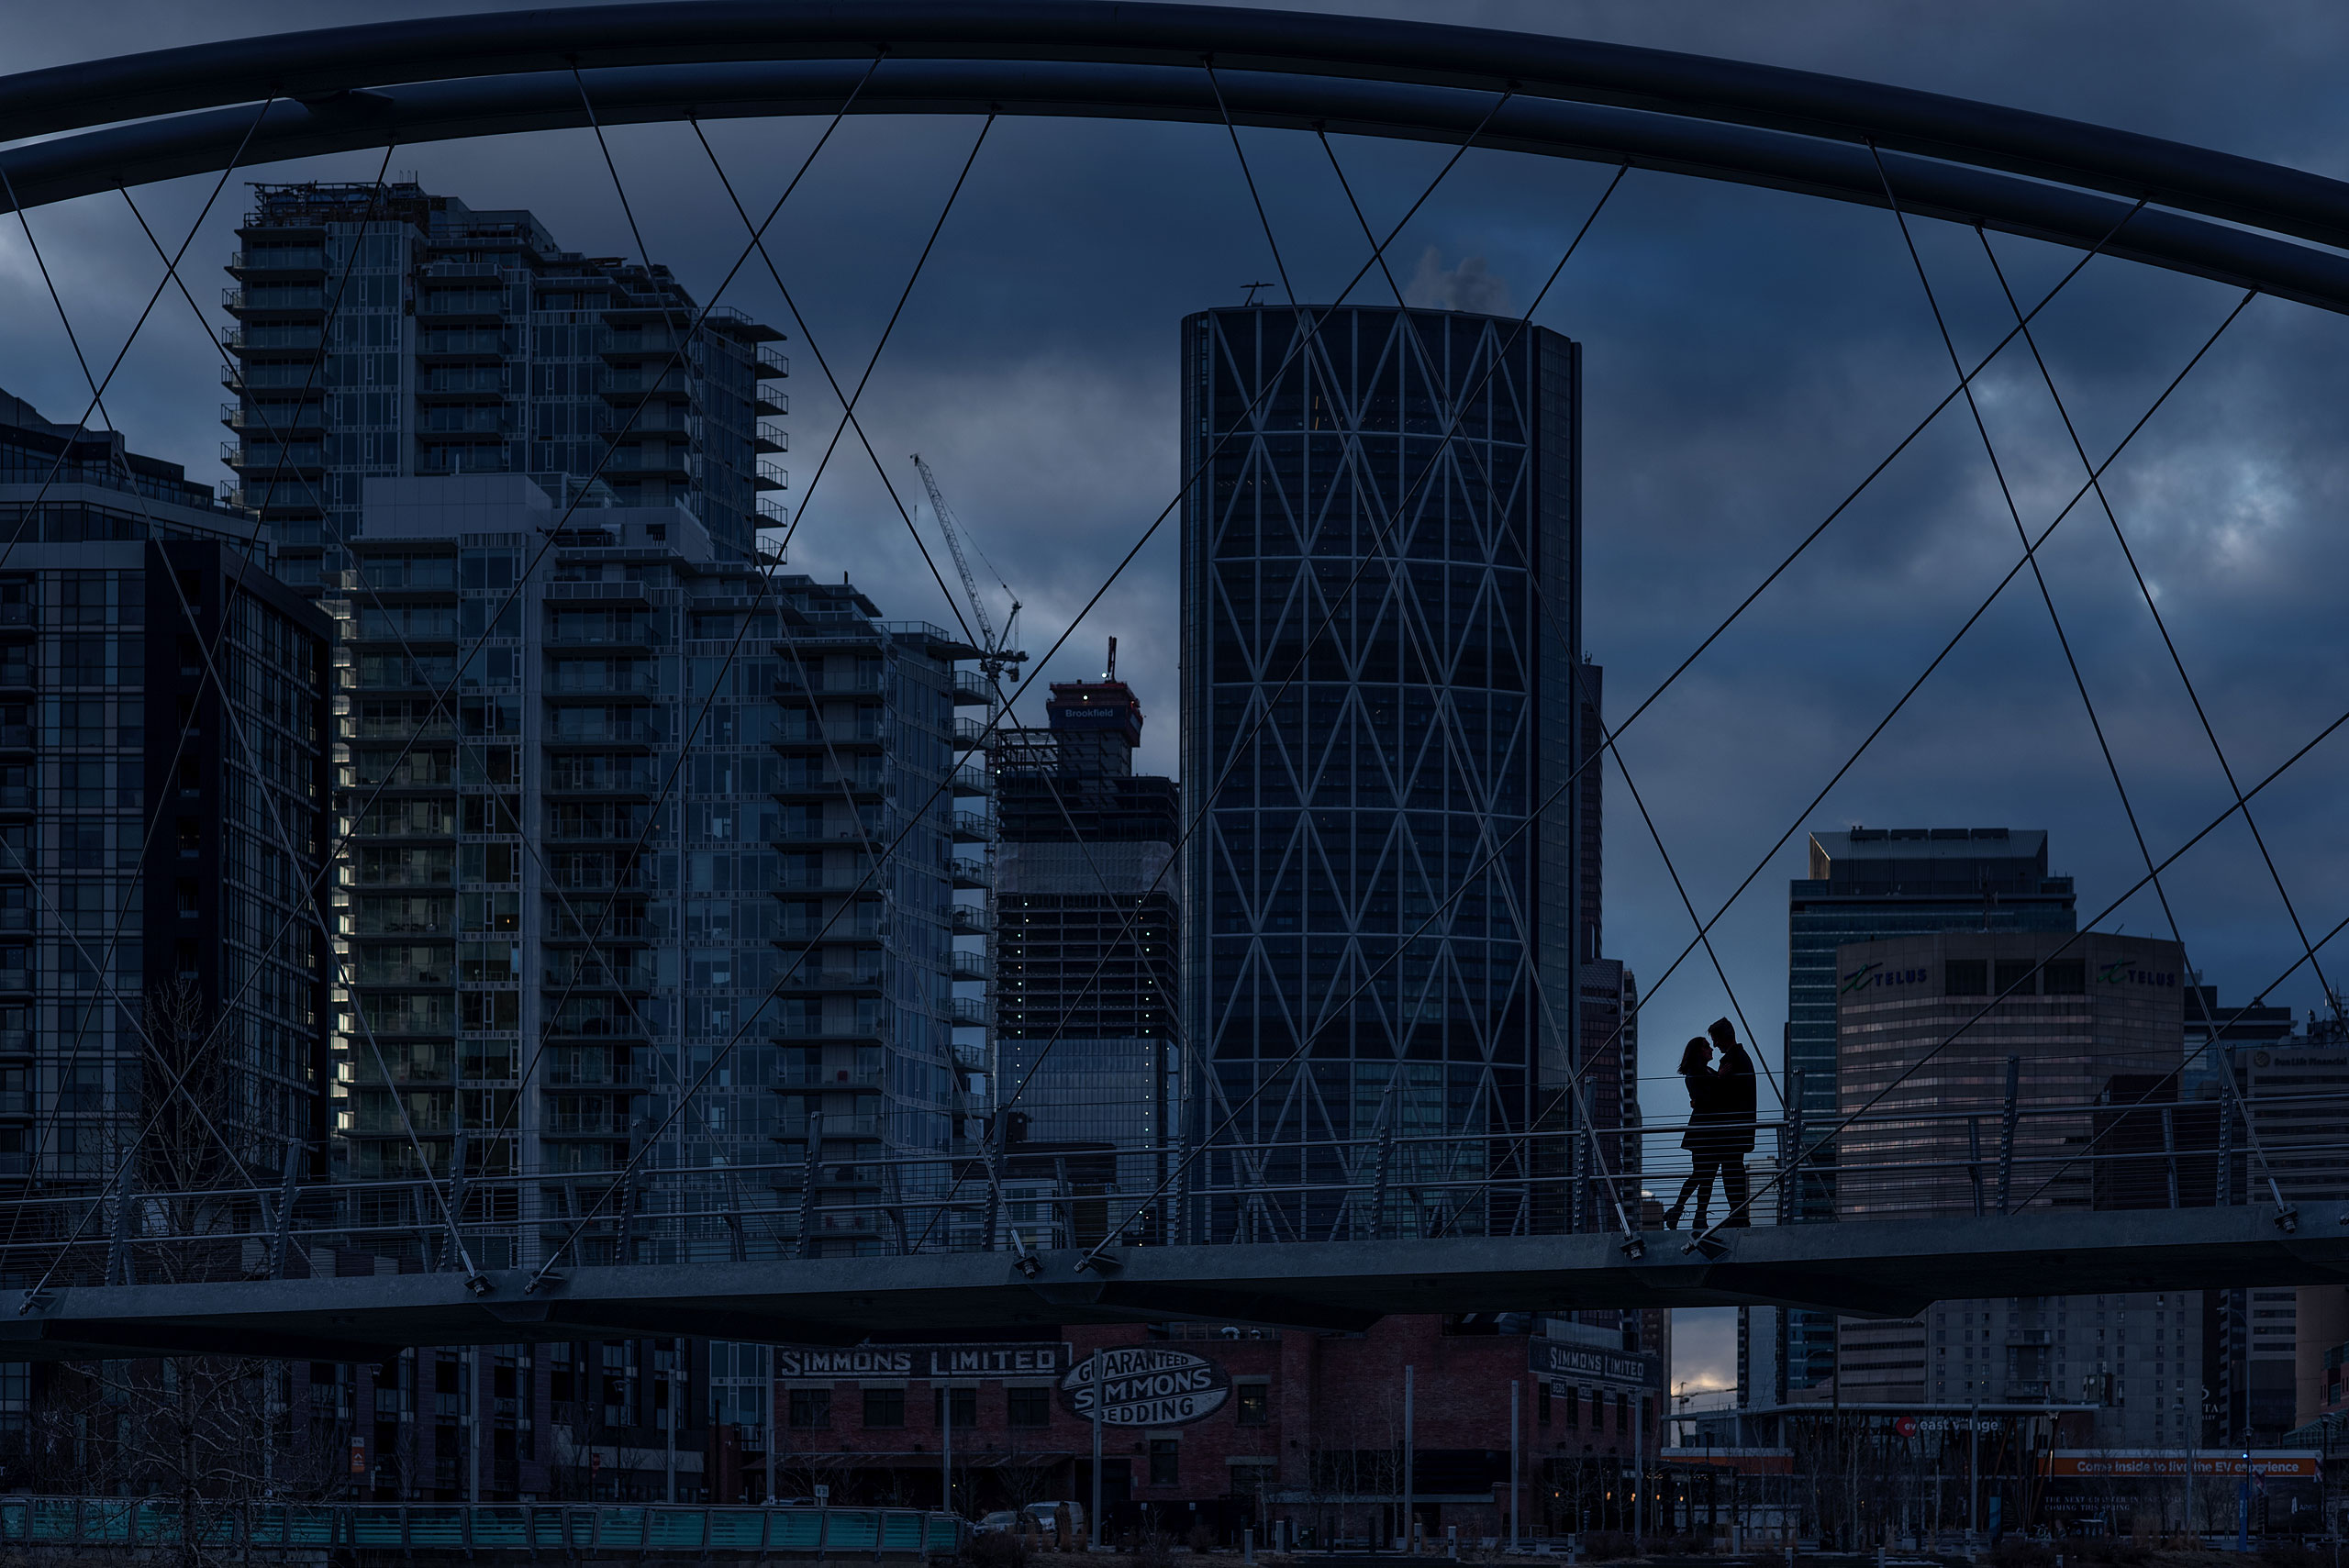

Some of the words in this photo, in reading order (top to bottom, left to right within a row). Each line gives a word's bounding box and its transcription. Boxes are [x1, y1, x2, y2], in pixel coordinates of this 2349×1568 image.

[1065, 709, 1113, 717] Brookfield
[1874, 968, 1927, 986] TELUS
[2128, 969, 2176, 987] TELUS
[782, 1351, 911, 1376] SIMMONS
[930, 1351, 1055, 1375] LIMITED
[1550, 1347, 1602, 1373] SIMMONS
[1605, 1354, 1644, 1379] LIMITED
[1074, 1368, 1211, 1409] SMMONS
[1920, 1418, 1950, 1430] east
[1952, 1418, 1999, 1433] vlge
[2215, 1462, 2232, 1472] EV
